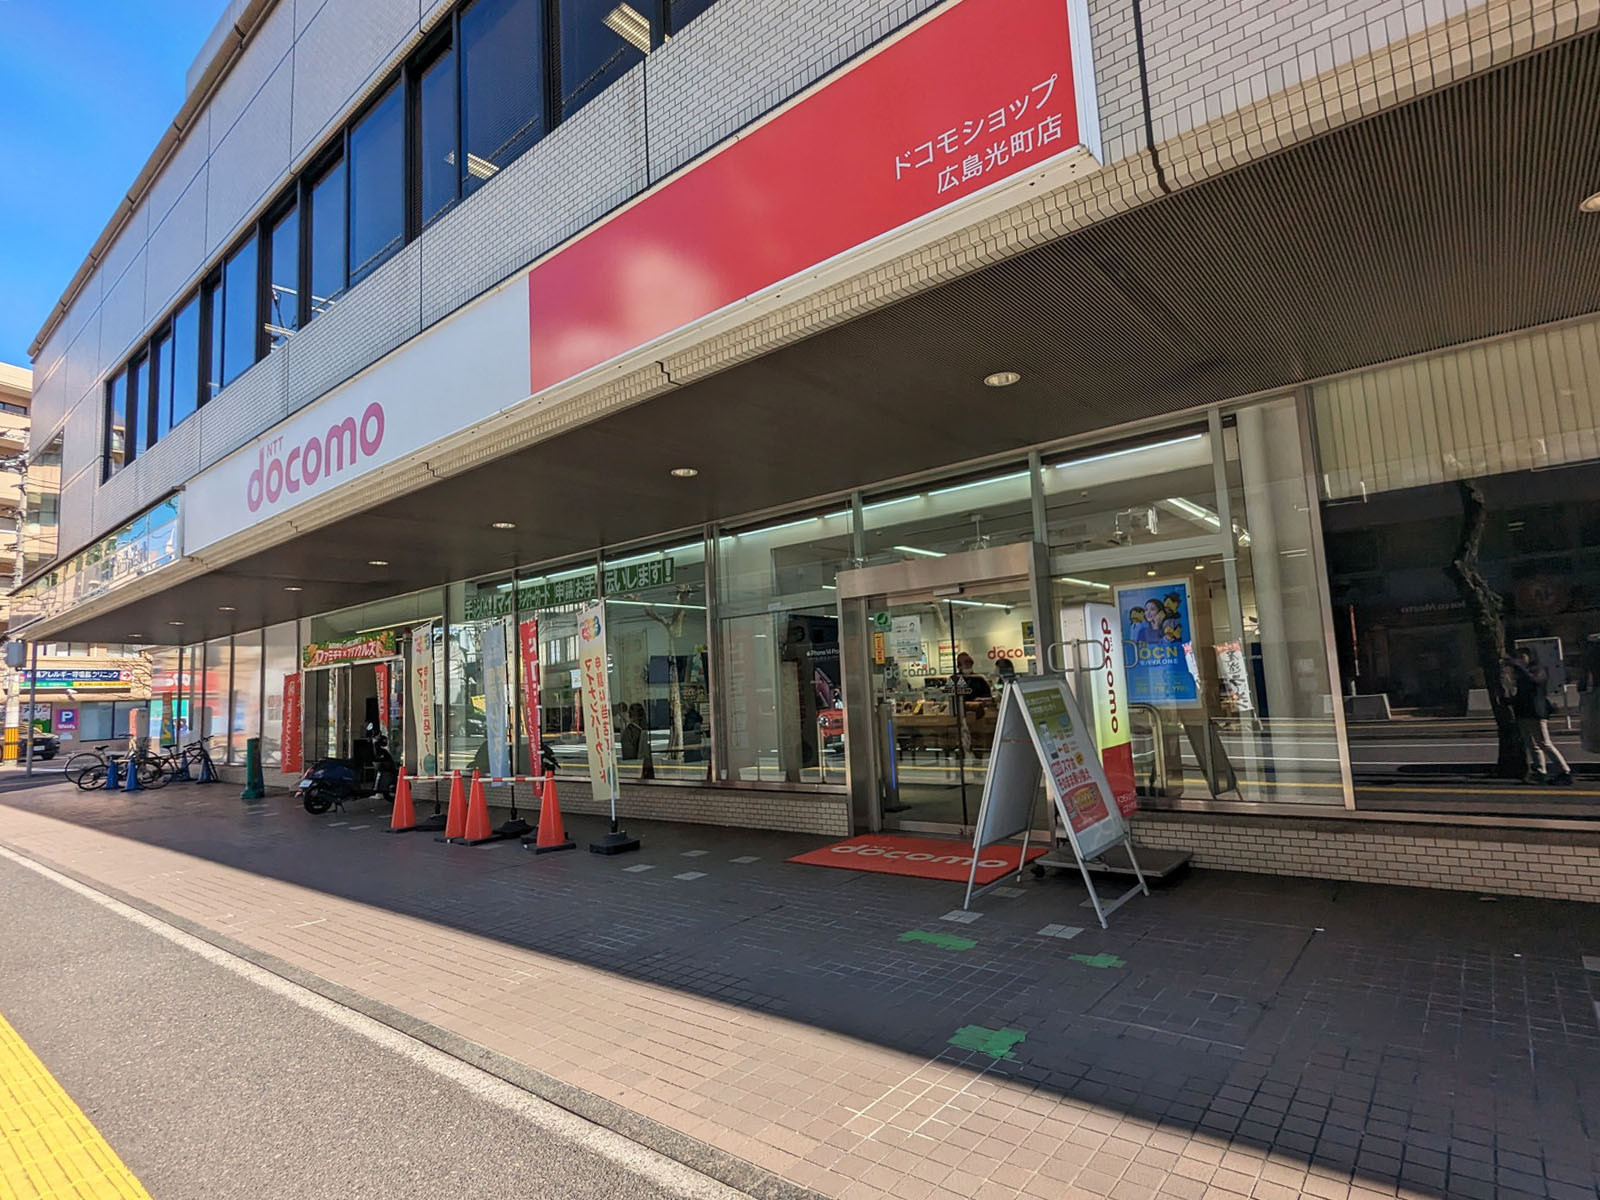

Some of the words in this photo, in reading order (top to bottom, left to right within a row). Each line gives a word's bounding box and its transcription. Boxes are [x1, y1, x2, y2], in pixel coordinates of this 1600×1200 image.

[894, 73, 1058, 180] ドコモショップ
[937, 113, 1063, 194] 広島光町店
[247, 401, 385, 513] docomo
[266, 436, 284, 458] NTT
[1101, 617, 1119, 734] docomo
[1139, 646, 1178, 660] OCN
[61, 711, 73, 722] P
[830, 844, 1009, 868] docomo
